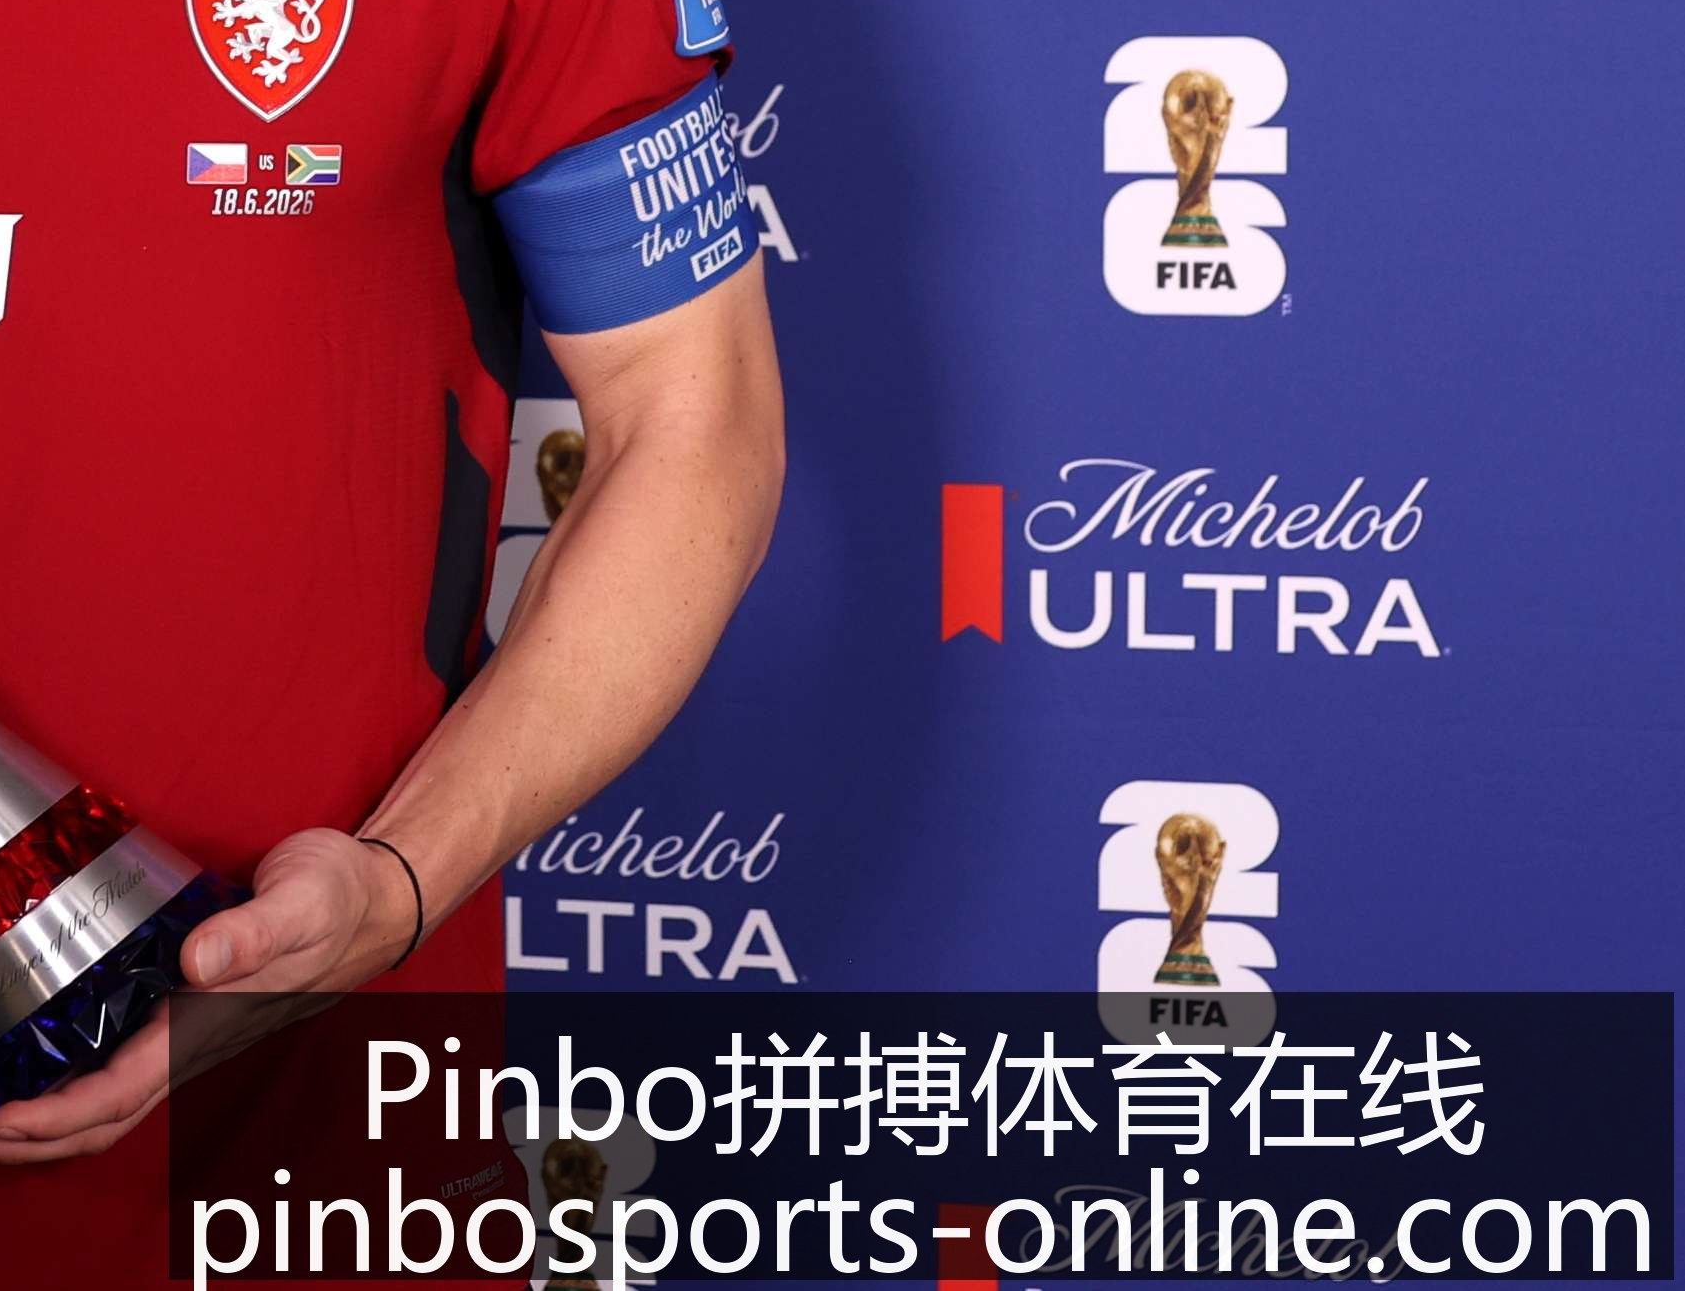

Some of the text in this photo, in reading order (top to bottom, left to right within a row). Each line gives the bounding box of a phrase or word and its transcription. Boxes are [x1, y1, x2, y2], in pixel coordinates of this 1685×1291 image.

[630, 119, 736, 222] UNITES
[212, 188, 315, 215] 18.6.2026
[632, 223, 692, 267] the
[695, 236, 740, 275] FIFA
[1156, 261, 1237, 290] FIFA
[1024, 459, 1428, 553] Michelob
[1030, 569, 1440, 657] ULTRA
[516, 808, 784, 882] ichelob
[506, 896, 798, 984] LTRA
[1149, 997, 1228, 1028] FIFA
